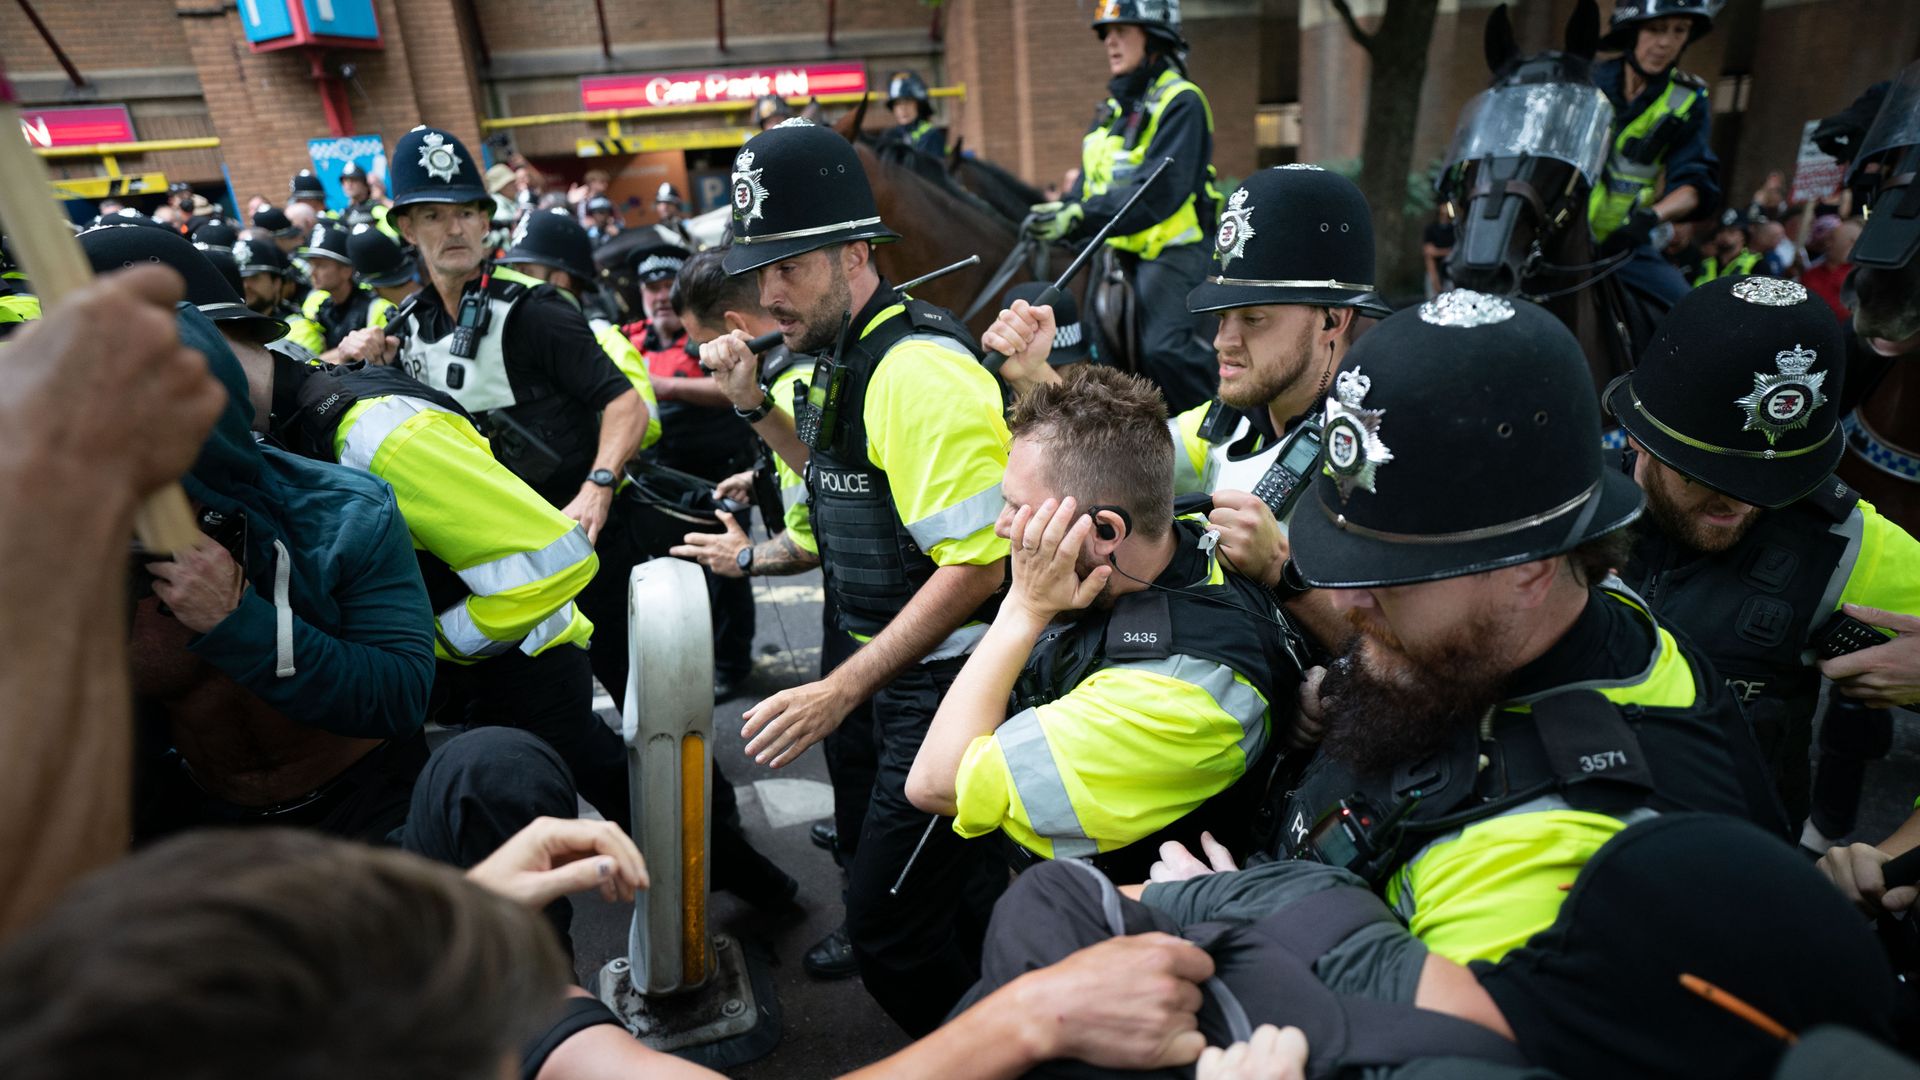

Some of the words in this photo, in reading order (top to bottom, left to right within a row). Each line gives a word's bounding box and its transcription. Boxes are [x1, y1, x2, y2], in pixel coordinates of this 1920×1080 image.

[645, 77, 700, 106] Car
[704, 73, 770, 100] Park
[775, 69, 808, 96] IN
[316, 392, 340, 415] 3086
[820, 470, 870, 493] POLICE
[1123, 631, 1158, 643] 3435
[1579, 749, 1627, 773] 3571
